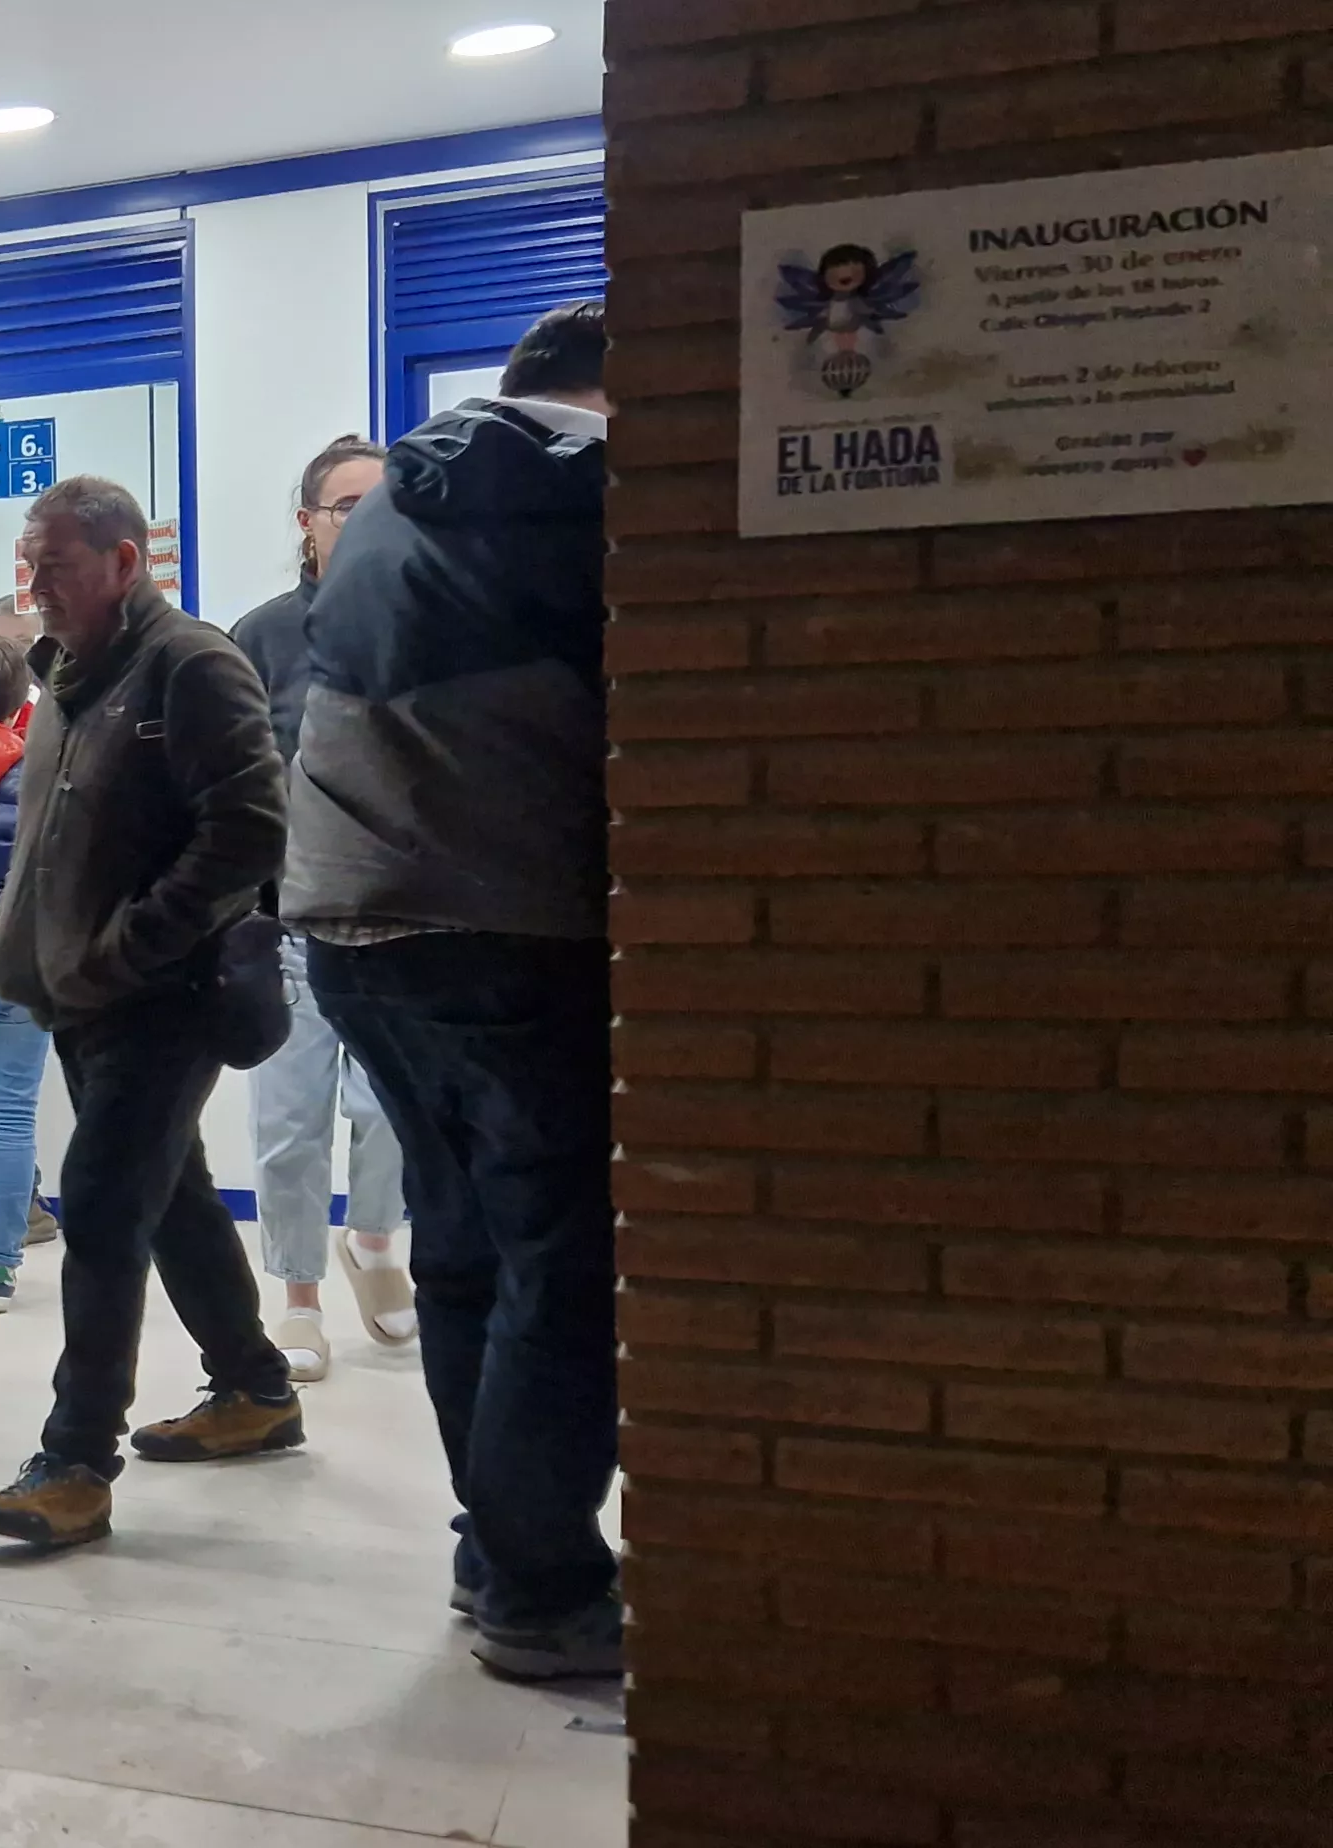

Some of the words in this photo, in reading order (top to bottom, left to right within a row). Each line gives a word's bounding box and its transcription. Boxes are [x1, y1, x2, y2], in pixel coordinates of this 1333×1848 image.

[969, 199, 1269, 252] INAUGURACIÓN
[974, 259, 1070, 284] Viernes
[1078, 253, 1114, 274] 30
[1120, 250, 1154, 270] de
[1162, 245, 1243, 266] enero
[1076, 365, 1089, 383] 2
[778, 434, 822, 475] EL
[833, 423, 941, 470] HADA
[777, 474, 803, 496] DE
[809, 471, 836, 493] LA
[841, 464, 941, 492] FORTUNA
